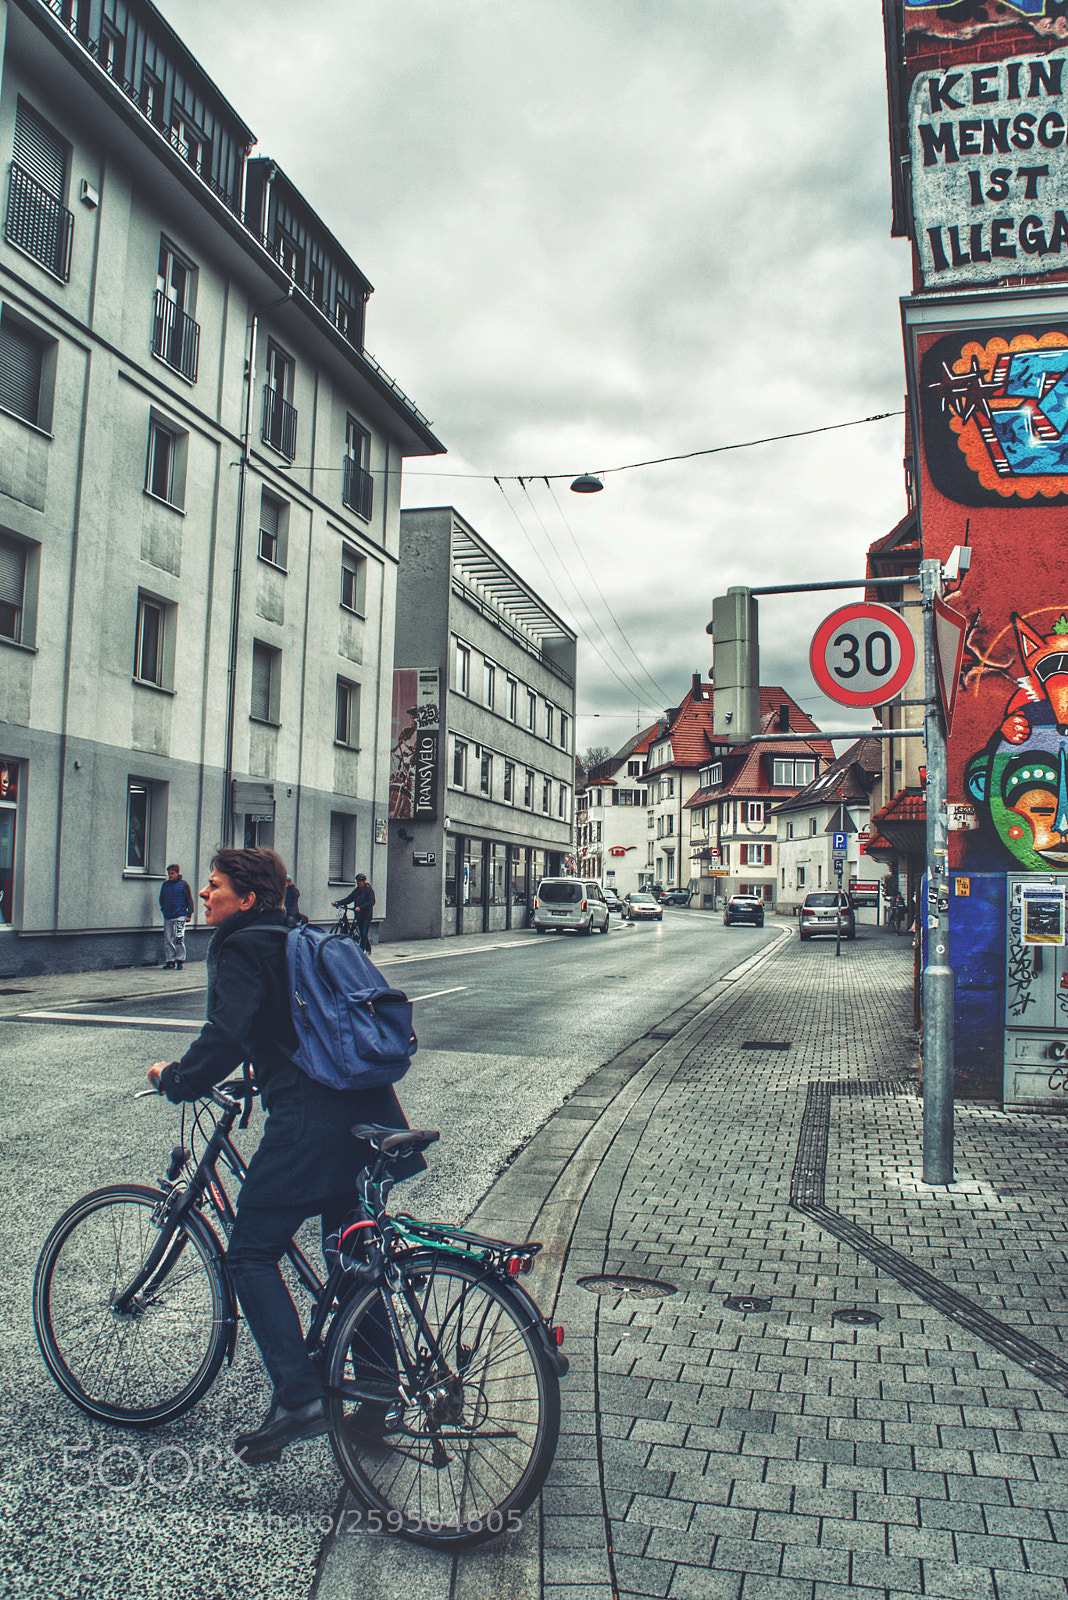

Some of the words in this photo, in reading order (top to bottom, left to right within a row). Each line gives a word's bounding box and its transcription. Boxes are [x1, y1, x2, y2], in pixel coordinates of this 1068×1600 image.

[928, 58, 1067, 114] KEIN
[918, 111, 1068, 167] MENSC
[967, 164, 1050, 206] IST
[833, 630, 892, 679] 30
[836, 834, 844, 848] P
